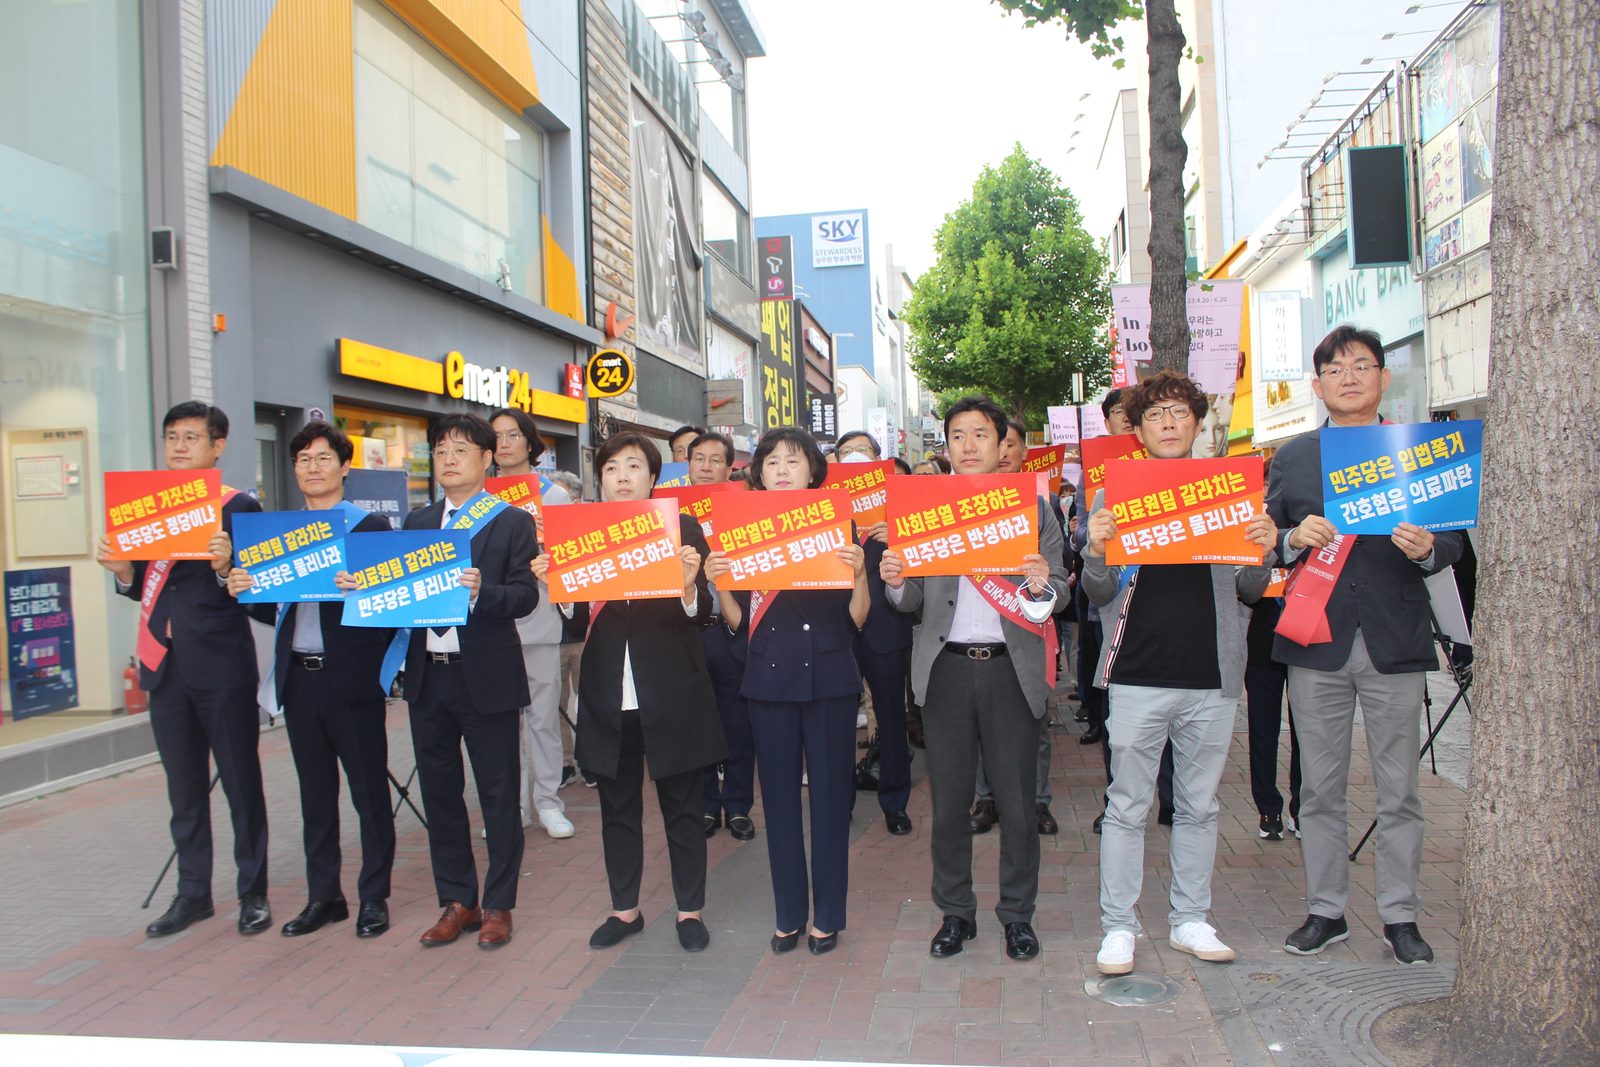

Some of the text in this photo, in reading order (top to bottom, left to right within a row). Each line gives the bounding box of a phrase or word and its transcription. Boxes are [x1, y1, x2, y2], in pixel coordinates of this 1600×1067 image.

[815, 247, 862, 256] STEWARDESS
[818, 219, 859, 238] SKY
[1188, 316, 1214, 325] 우리는
[1325, 269, 1366, 325] BANG
[762, 301, 793, 367] 폐업
[1122, 317, 1140, 330] In
[1125, 338, 1149, 352] Lo
[446, 350, 532, 413] emart24
[596, 357, 622, 367] emart
[596, 367, 624, 388] 24
[764, 365, 795, 429] 정리
[812, 398, 823, 433] COFFEE
[824, 404, 835, 436] DONUT
[843, 468, 886, 494] 간호협회
[1328, 431, 1466, 494] 민주당은 입법폭거
[109, 478, 208, 526] 입만열면 거짓선동
[895, 486, 1022, 538] 사회분열 조장하는
[1111, 471, 1248, 525] 의료원팀 갈라치는
[1339, 463, 1473, 525] 간호협은 의료파탄
[116, 504, 216, 553] 민주당도 정당이냐
[238, 521, 334, 568] 의료원팀 갈라치는
[550, 529, 608, 566] 간호사만
[607, 509, 665, 545] 투표하냐
[719, 518, 778, 553] 입만열면
[776, 498, 837, 533] 거짓선동
[903, 514, 1031, 568] 민주당은 반성하라
[1120, 500, 1255, 555] 민주당은 물러나라
[292, 545, 343, 578] 물러나라
[353, 541, 457, 591] 의료원팀 갈라치는
[560, 537, 676, 593] 민주당은 각오하라
[729, 527, 847, 582] 민주당도 정당이냐
[357, 585, 412, 619] 민주당은
